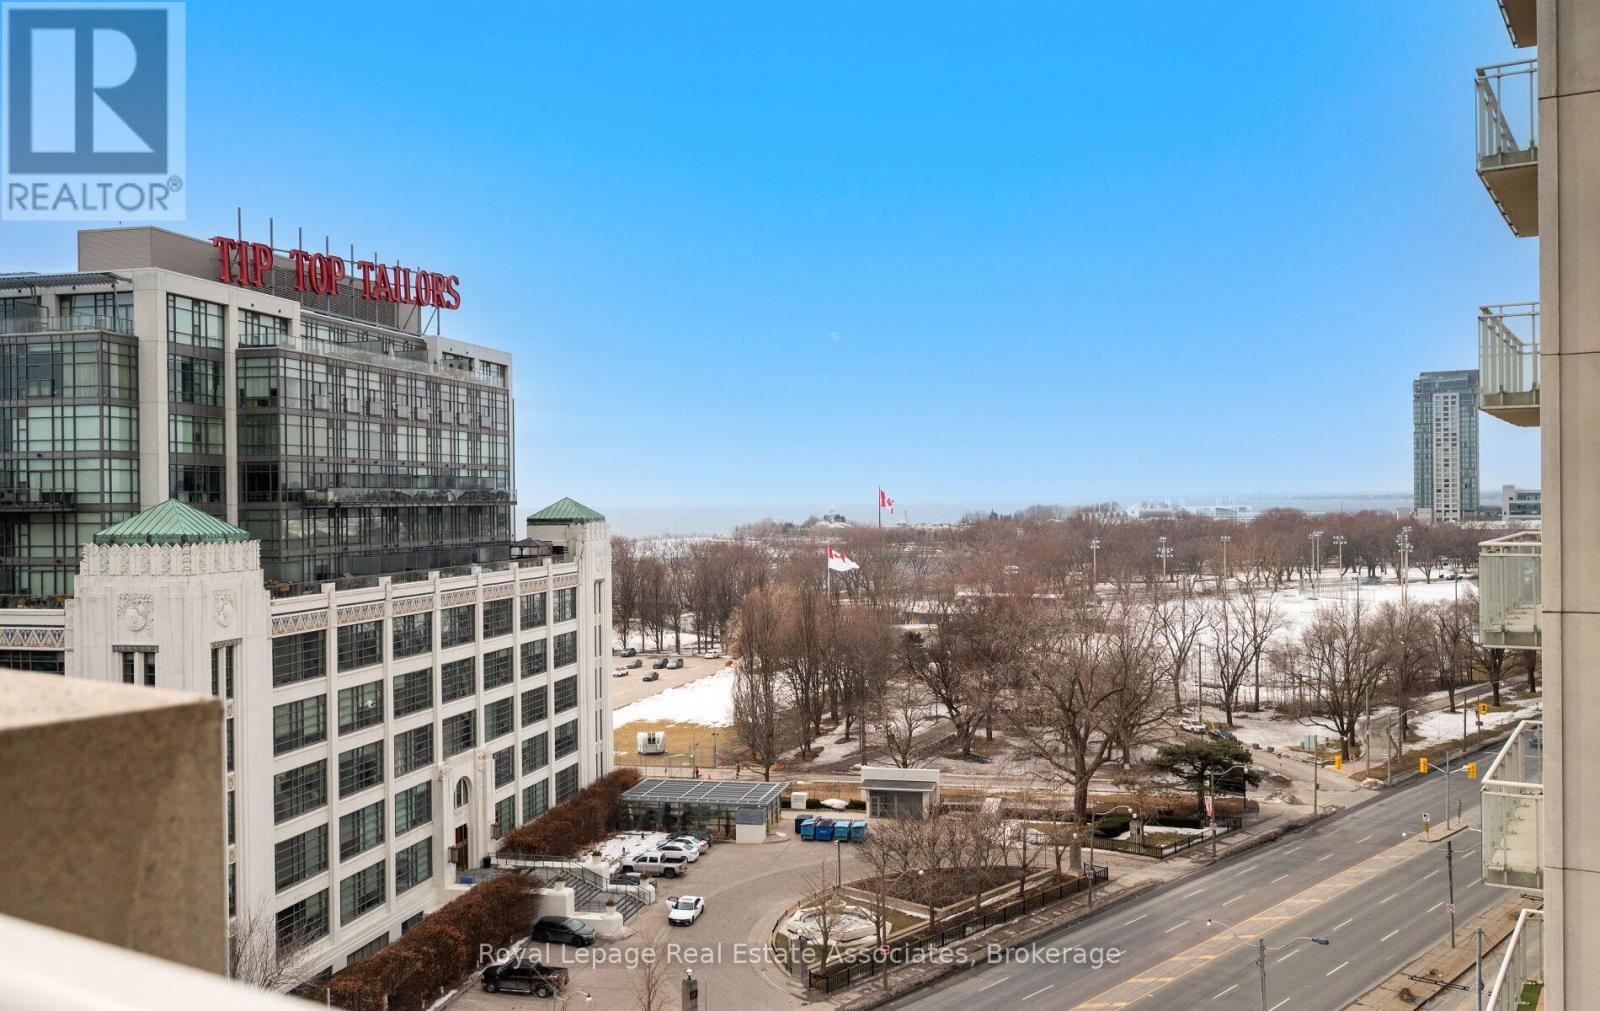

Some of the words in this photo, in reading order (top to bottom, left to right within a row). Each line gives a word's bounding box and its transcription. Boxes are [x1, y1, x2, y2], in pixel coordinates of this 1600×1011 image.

[211, 235, 274, 287] TIP
[289, 249, 346, 296] TOP
[357, 260, 461, 310] TAILORS
